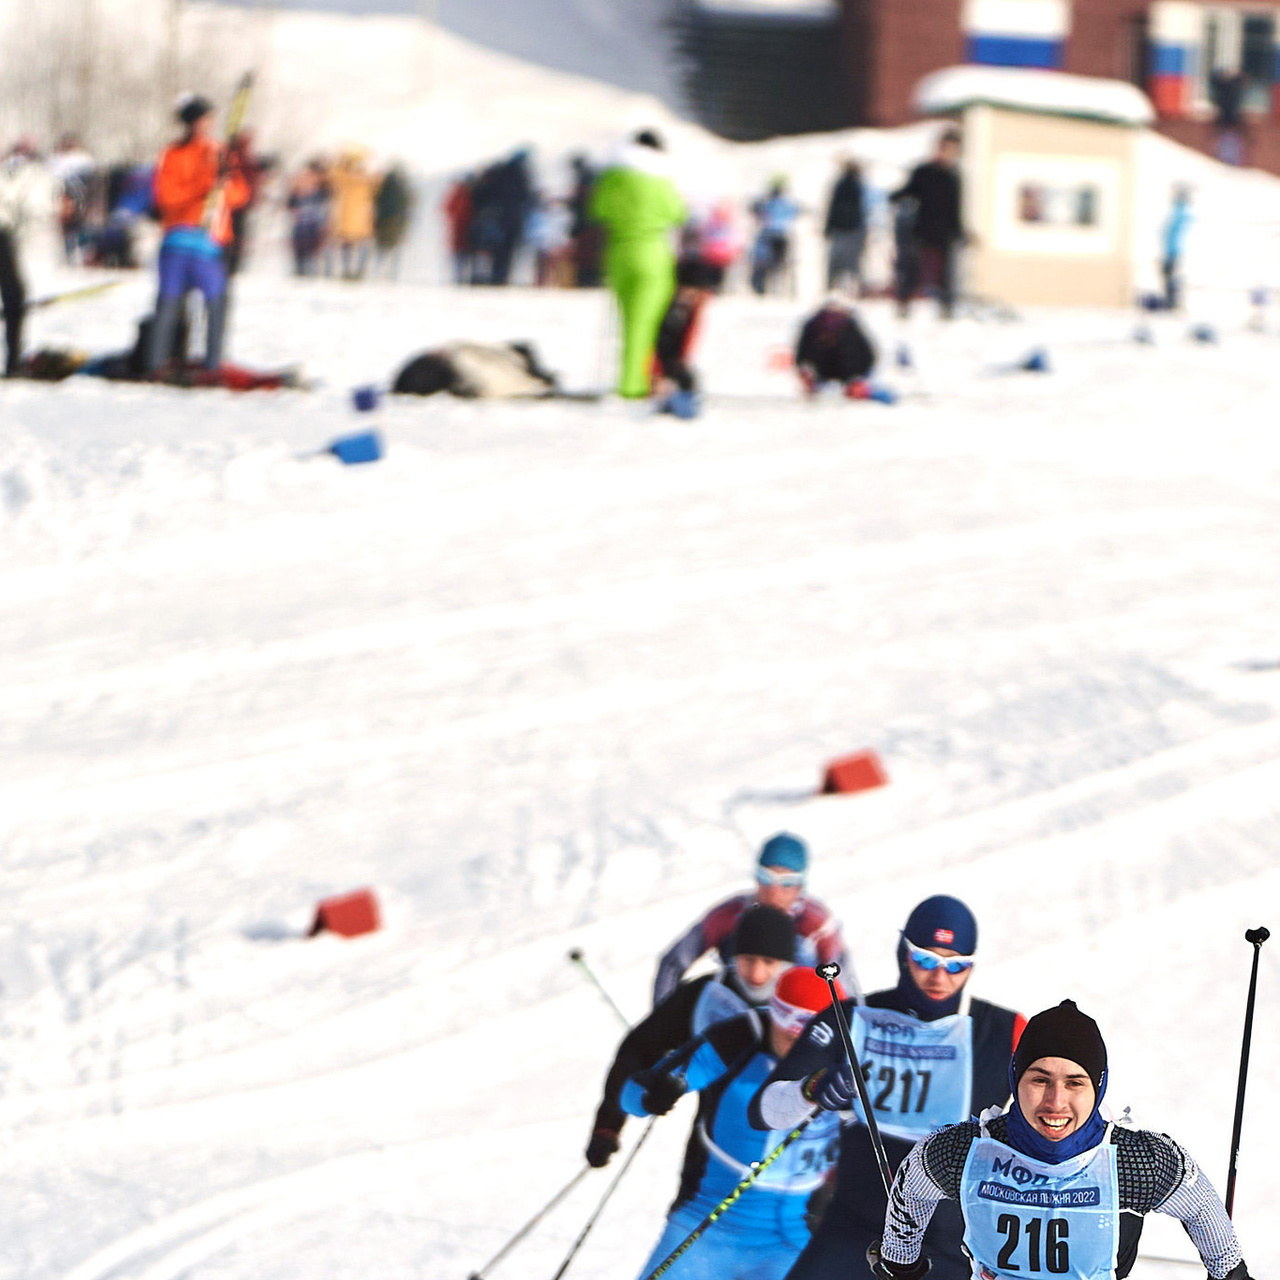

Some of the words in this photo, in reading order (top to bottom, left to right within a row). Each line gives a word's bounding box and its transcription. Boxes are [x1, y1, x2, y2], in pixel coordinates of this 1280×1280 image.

[873, 1065, 932, 1114] 217
[980, 1183, 1038, 1203] МОСКОВСКАЯ
[1040, 1192, 1071, 1205] ЛЫЖНЯ
[1072, 1190, 1096, 1204] 2022
[996, 1213, 1071, 1274] 216
